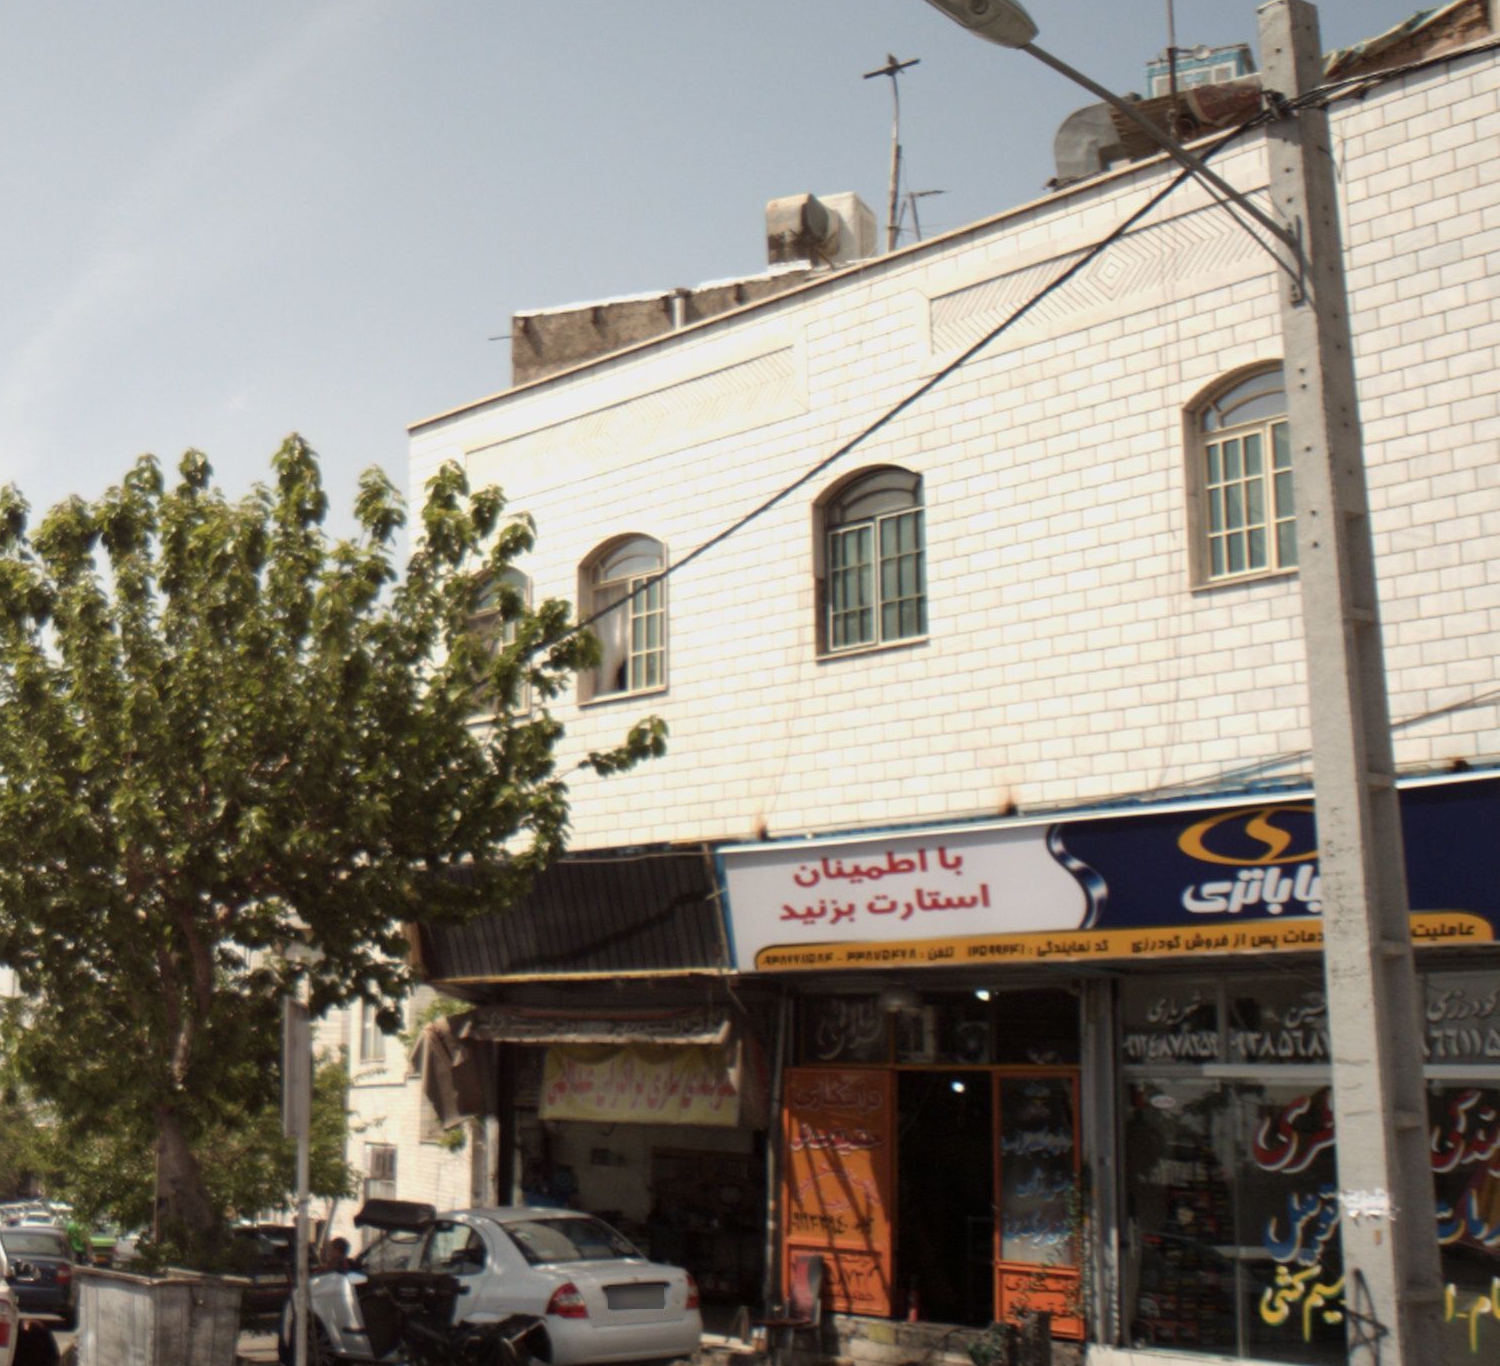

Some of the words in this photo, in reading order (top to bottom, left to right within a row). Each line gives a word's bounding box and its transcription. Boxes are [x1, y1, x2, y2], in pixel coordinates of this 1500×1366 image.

[793, 848, 928, 887] اطمینان
[937, 846, 964, 875] با
[866, 883, 991, 920] استارت
[779, 897, 856, 926] بزنید
[1231, 933, 1247, 948] از
[1251, 933, 1278, 949] پس
[1283, 928, 1324, 945] دمات
[1411, 922, 1475, 941] عاملیت
[1036, 939, 1091, 957] نمایندگی
[1093, 939, 1110, 952] کد
[1130, 934, 1181, 954] گودرزی
[1185, 932, 1231, 951] فروش
[927, 945, 955, 961] تلفن
